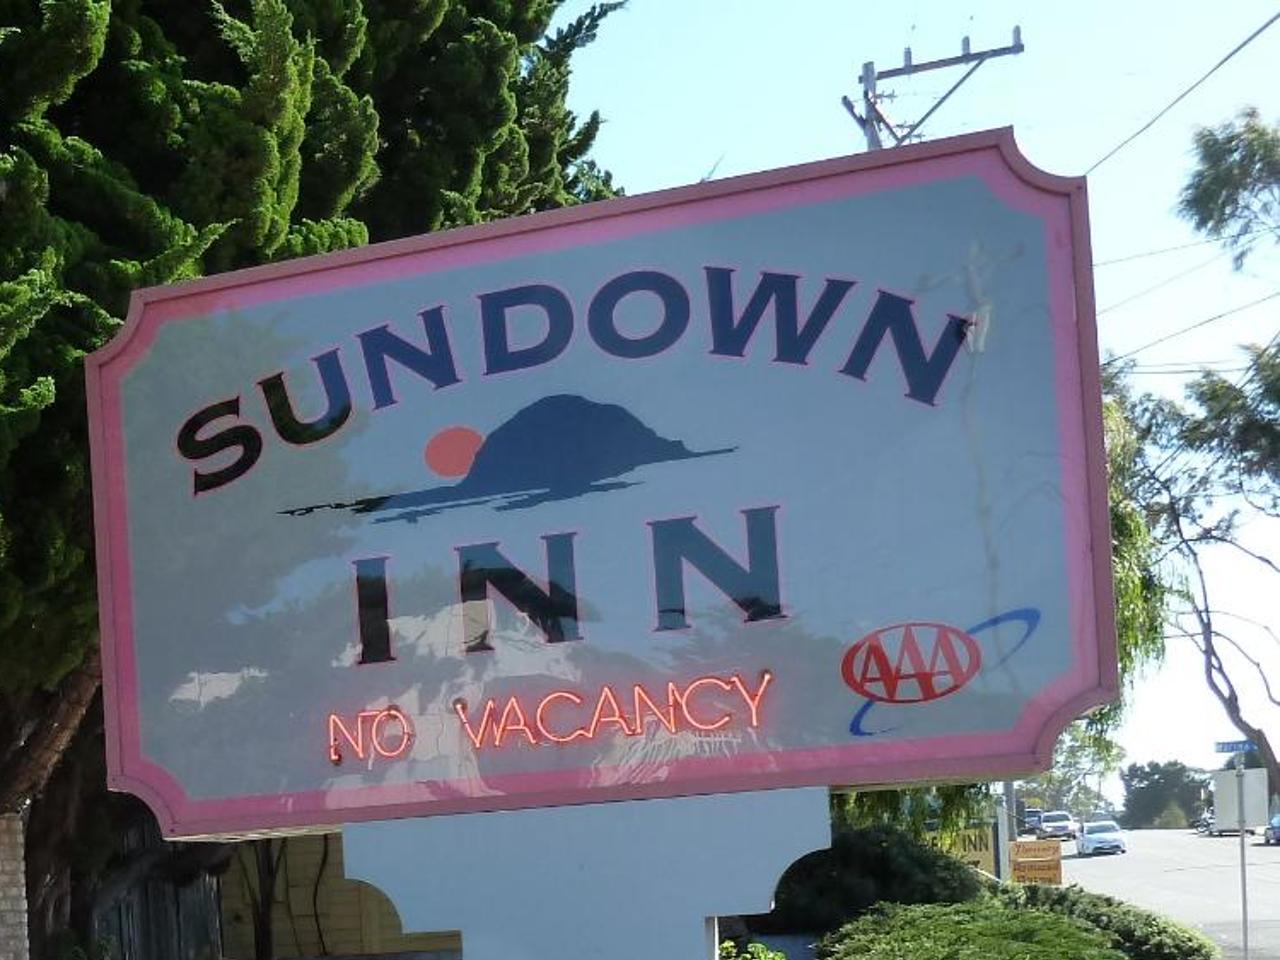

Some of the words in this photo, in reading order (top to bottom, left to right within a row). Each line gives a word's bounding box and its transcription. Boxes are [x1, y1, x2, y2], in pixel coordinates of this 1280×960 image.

[175, 265, 973, 497] SUNDOWN
[351, 504, 789, 665] INN
[329, 705, 410, 761] NO
[455, 671, 773, 748] VACANCY
[857, 623, 970, 701] AAA
